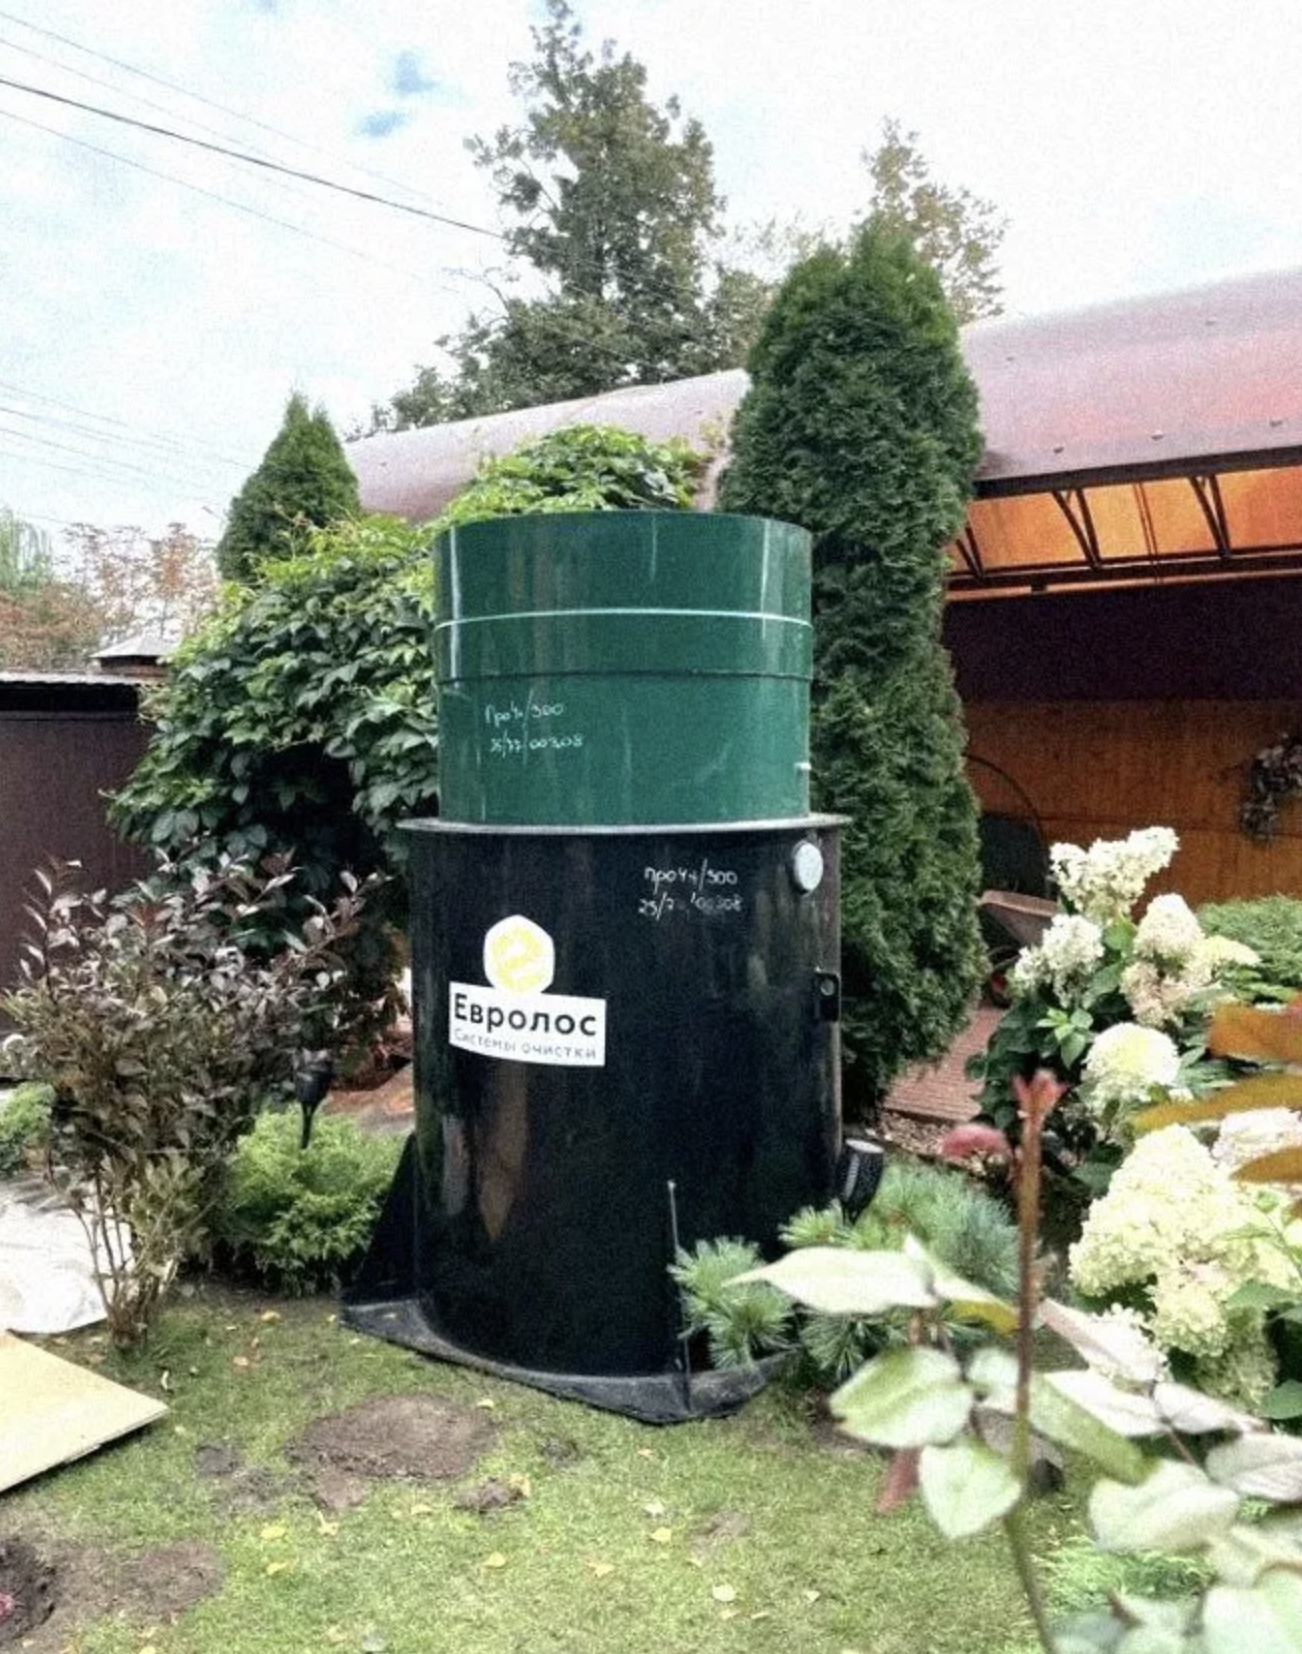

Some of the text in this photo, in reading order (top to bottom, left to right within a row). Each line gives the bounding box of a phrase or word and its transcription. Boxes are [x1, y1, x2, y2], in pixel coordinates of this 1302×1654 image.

[454, 992, 597, 1037] Евролос
[454, 1028, 597, 1060] Системы очистки
